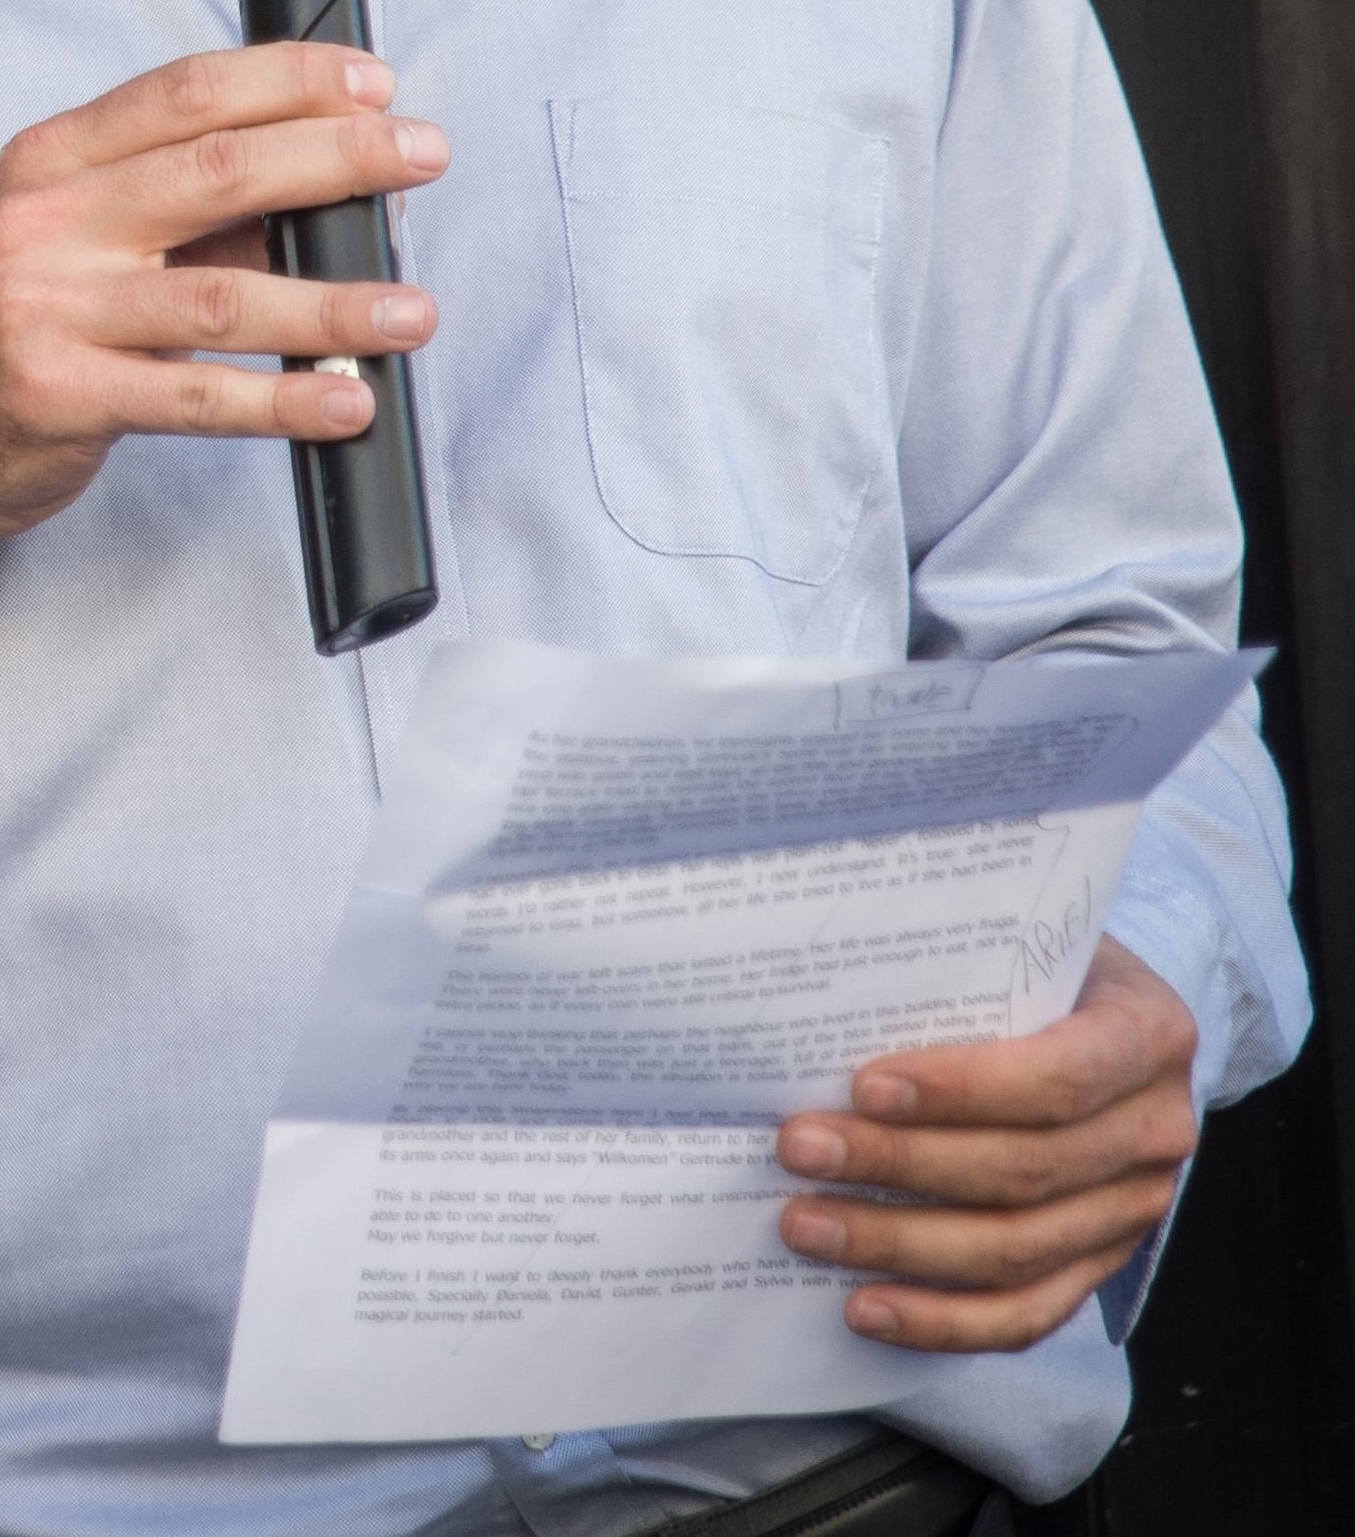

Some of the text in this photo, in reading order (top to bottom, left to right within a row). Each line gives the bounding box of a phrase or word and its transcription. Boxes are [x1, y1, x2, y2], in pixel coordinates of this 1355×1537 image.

[382, 1128, 475, 1145] grandmother
[480, 1129, 508, 1142] and
[513, 1129, 538, 1143] the
[542, 1130, 569, 1143] rest
[594, 1130, 618, 1144] her
[677, 1132, 722, 1146] return
[746, 1132, 771, 1146] her
[379, 1148, 397, 1162] its
[399, 1152, 437, 1163] arms
[439, 1152, 476, 1163] once
[479, 1150, 519, 1167] again
[522, 1150, 552, 1164] and
[554, 1154, 588, 1168] says
[679, 1152, 742, 1166] Gertrude
[373, 1188, 404, 1202] This
[428, 1189, 478, 1206] placed
[506, 1190, 538, 1204] that
[570, 1194, 614, 1204] never
[619, 1190, 664, 1208] forget
[669, 1189, 706, 1204] what
[371, 1208, 401, 1222] able
[465, 1212, 494, 1223] one
[497, 1210, 556, 1224] another.
[367, 1230, 397, 1247] May
[426, 1230, 477, 1248] forgive
[479, 1230, 506, 1244] but
[508, 1234, 550, 1244] never
[553, 1231, 599, 1248] forget.
[360, 1268, 409, 1282] Before
[426, 1268, 467, 1282] finish
[484, 1268, 522, 1282] want
[599, 1266, 640, 1281] thank
[644, 1262, 716, 1281] everybody
[721, 1259, 752, 1274] who
[756, 1257, 791, 1271] have
[426, 1288, 489, 1306] Specially
[670, 1278, 717, 1294] Gerald
[721, 1275, 750, 1290] and
[800, 1273, 832, 1288] with
[354, 1307, 409, 1324] magical
[413, 1307, 466, 1324] journey
